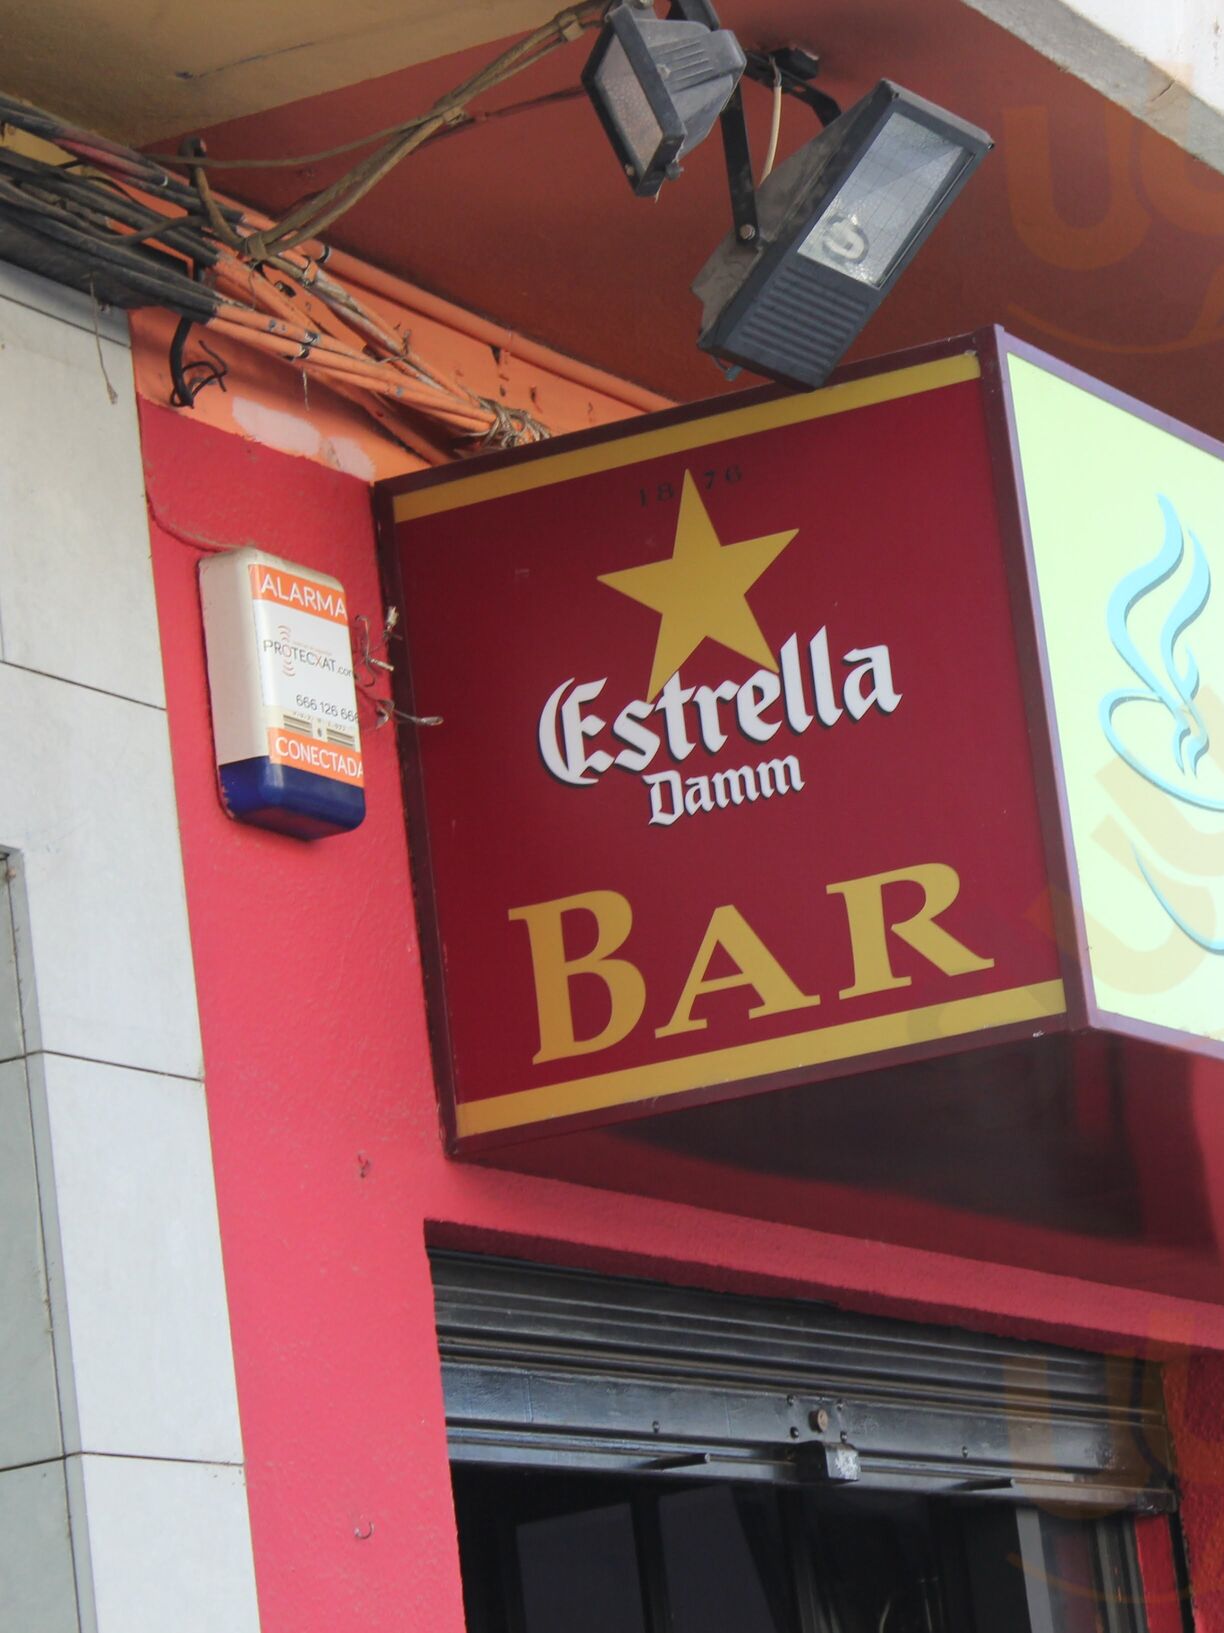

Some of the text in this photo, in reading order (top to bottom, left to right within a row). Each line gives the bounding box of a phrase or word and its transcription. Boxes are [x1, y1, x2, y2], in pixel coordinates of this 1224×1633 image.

[260, 573, 348, 622] ALARMA
[538, 626, 902, 786] Estrella
[642, 755, 805, 826] Damm
[508, 862, 995, 1064] BAR
